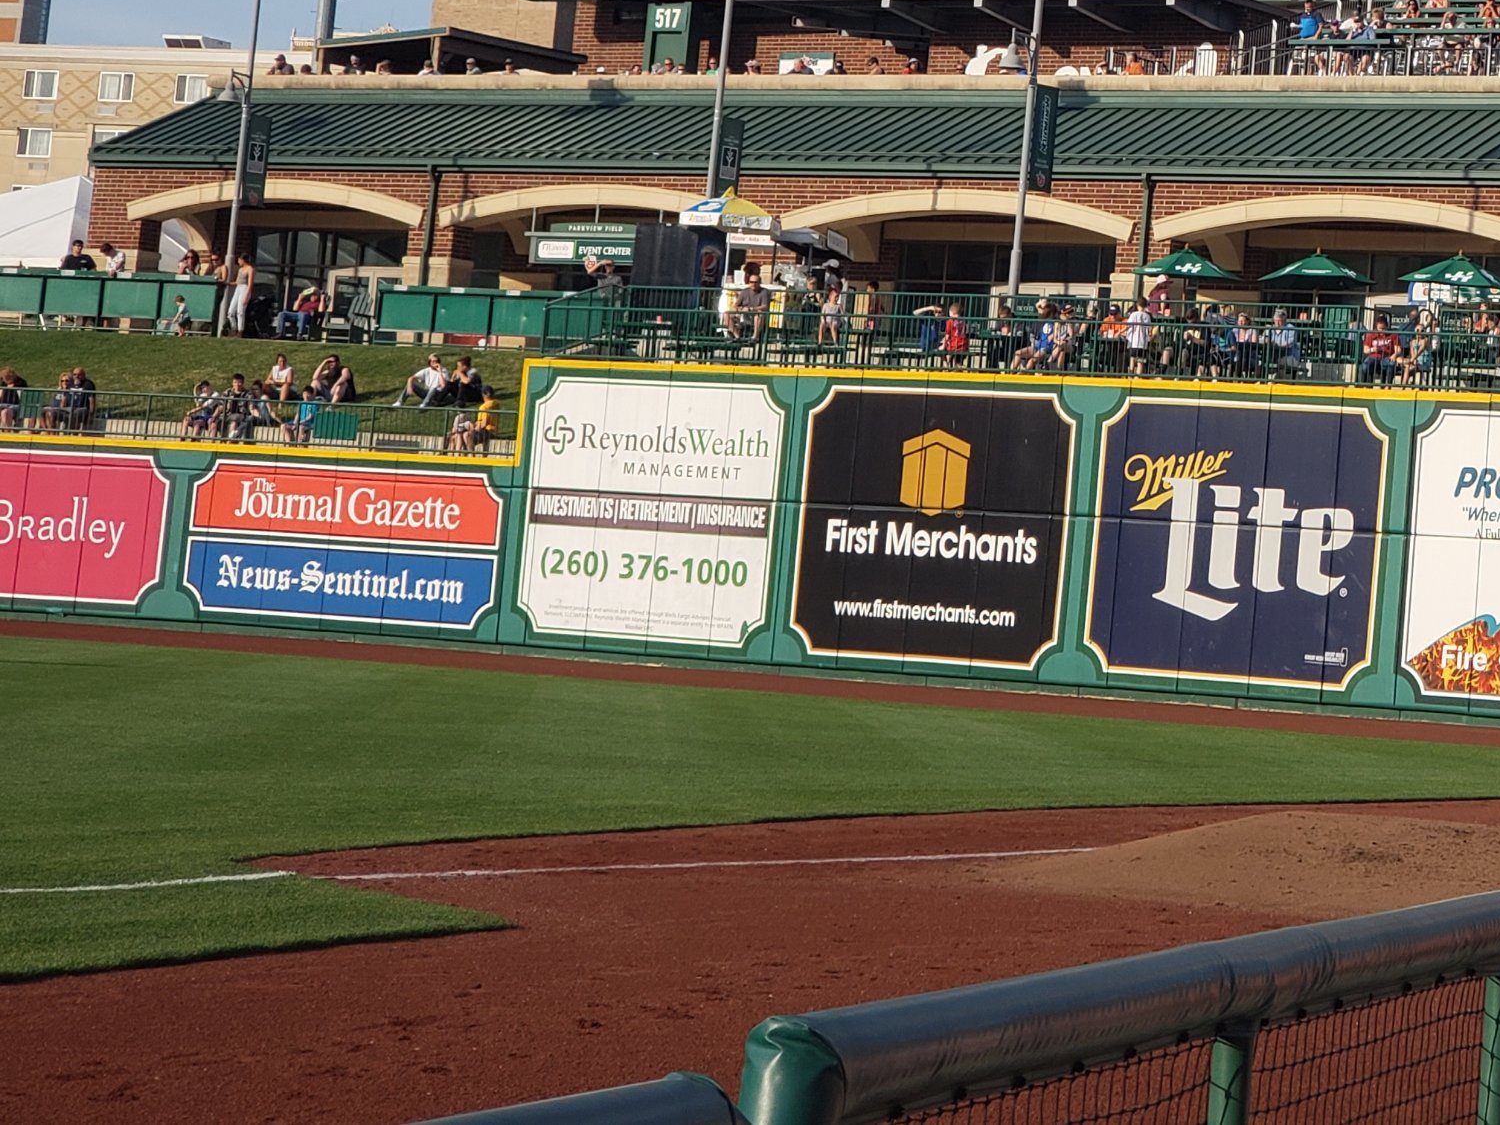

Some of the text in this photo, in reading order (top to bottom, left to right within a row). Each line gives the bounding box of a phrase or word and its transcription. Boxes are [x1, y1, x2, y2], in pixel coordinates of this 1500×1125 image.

[655, 8, 682, 29] 517
[568, 224, 624, 233] PARKVIEW FIELD
[578, 246, 602, 257] EVENT
[602, 246, 632, 257] CENTER
[253, 477, 277, 493] The
[622, 461, 742, 481] MANAGEMENT
[1124, 450, 1233, 503] Miller
[234, 479, 461, 531] Journal Gazette
[533, 493, 767, 530] INVESTMENTS RETIREMENT INSURANCE
[825, 518, 1038, 565] First Merchants
[1152, 477, 1355, 622] Lite
[216, 553, 465, 605] News-Sentinel.com
[540, 546, 749, 588] (260) 376-1000
[833, 598, 1016, 627] www.firstmerchants.com
[1440, 644, 1489, 672] Fire
